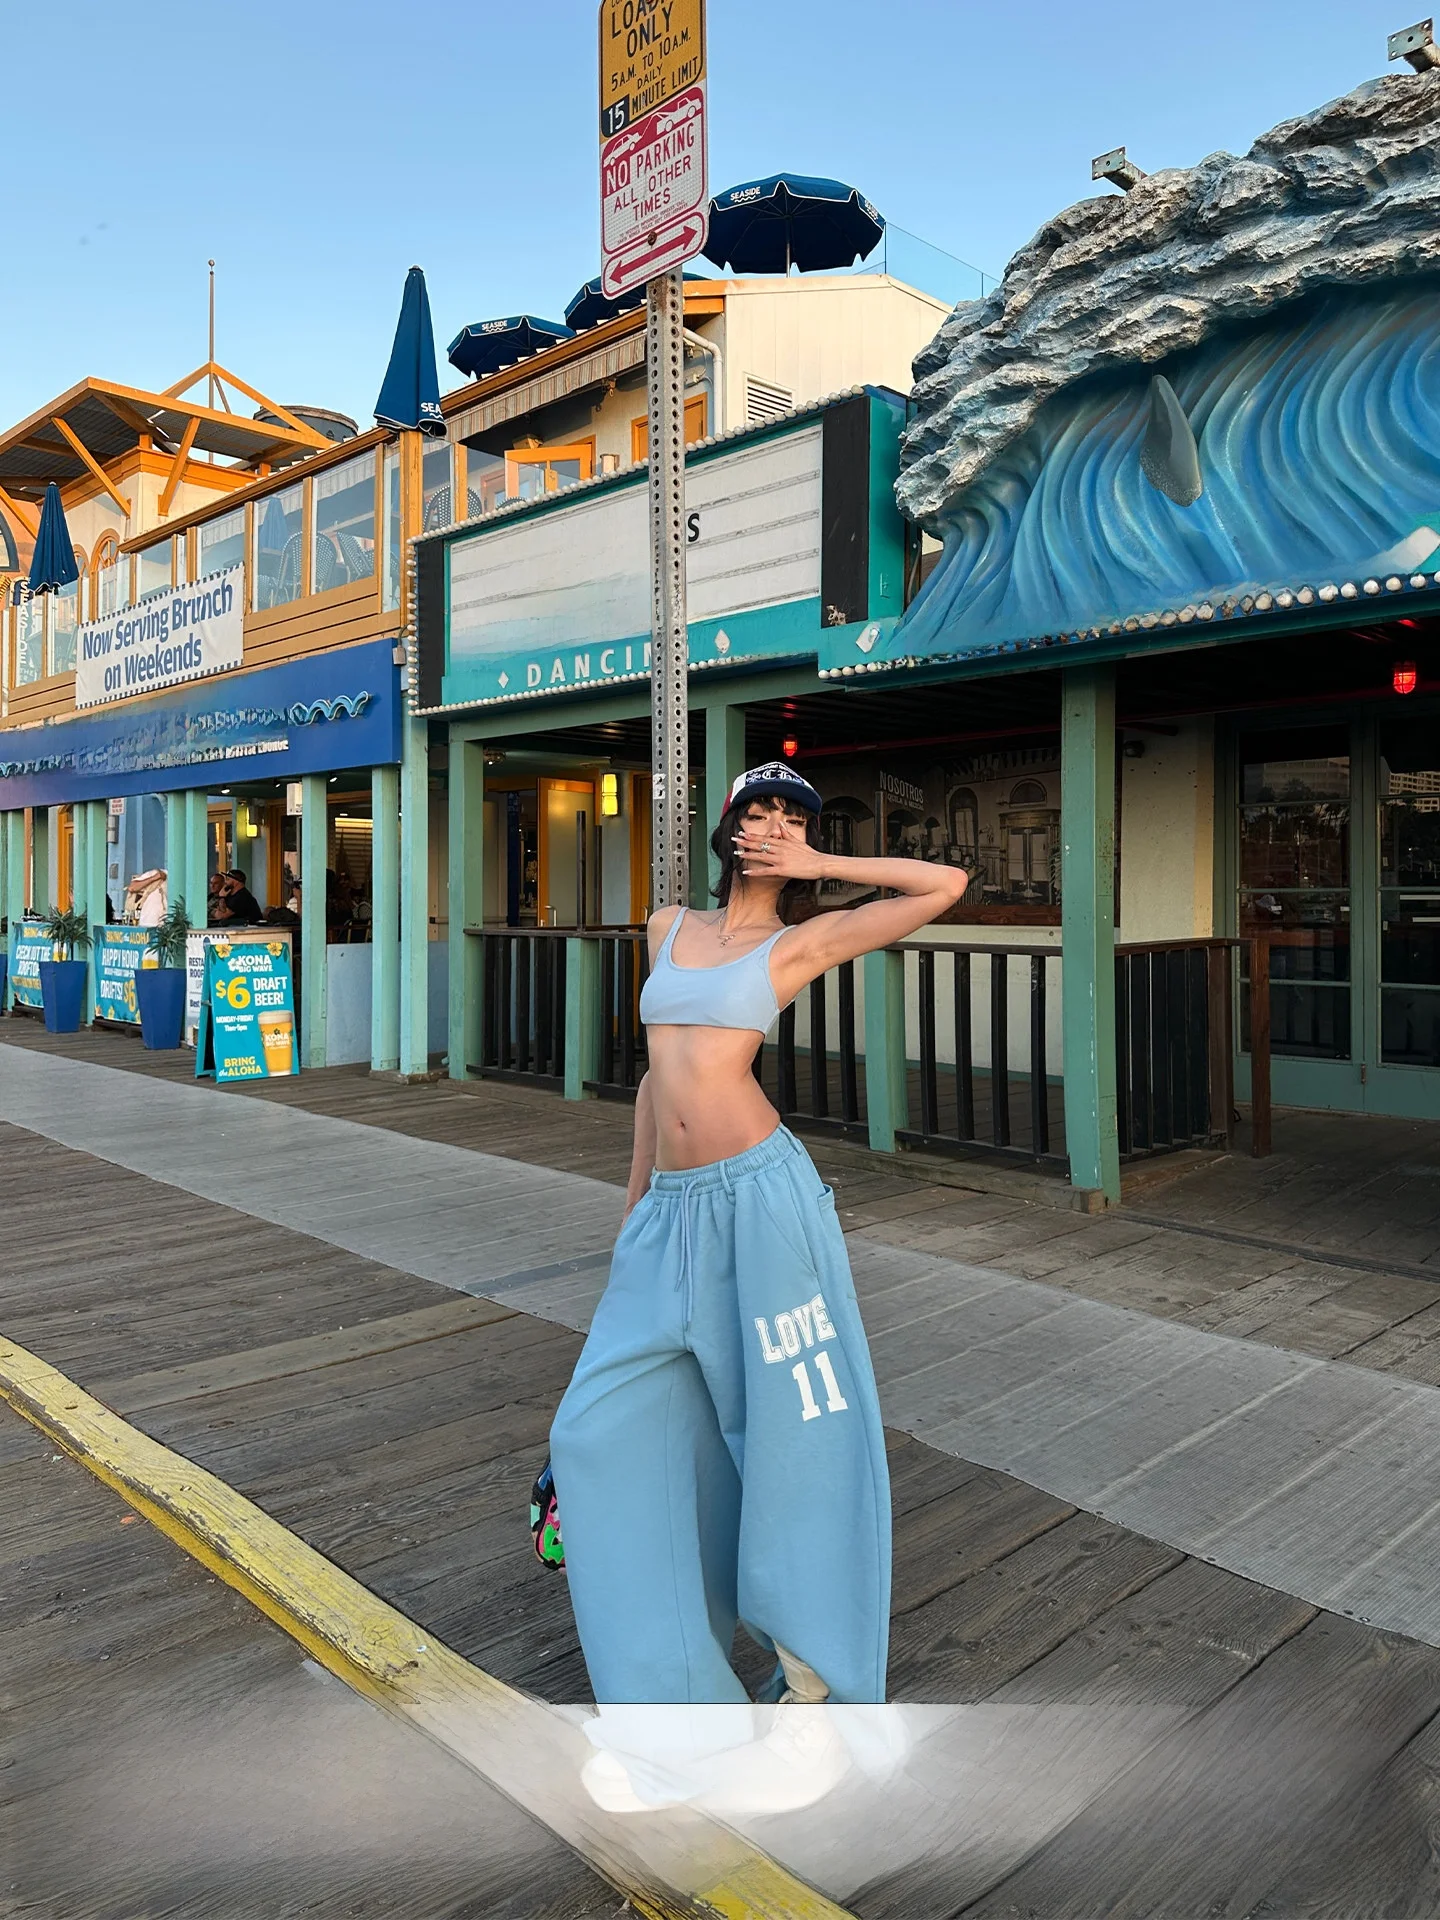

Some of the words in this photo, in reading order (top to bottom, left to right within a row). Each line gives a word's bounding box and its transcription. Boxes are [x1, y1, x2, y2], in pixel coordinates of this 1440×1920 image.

[627, 1, 673, 57] ONLY
[637, 63, 663, 90] DAILY
[643, 52, 654, 71] TO
[608, 100, 625, 134] 15
[631, 77, 666, 115] MINUTE
[671, 56, 698, 90] LIMIT
[606, 160, 628, 196] NO
[636, 122, 695, 178] PARKING
[614, 187, 638, 214] ALL
[648, 154, 691, 192] OTHER
[730, 186, 761, 201] SEASIDE
[632, 187, 671, 221] TIMES
[481, 319, 508, 331] SEASIDE
[687, 512, 700, 543] S
[83, 628, 113, 661] Now
[115, 605, 169, 650] Serving
[172, 578, 233, 631] Brunch
[104, 662, 121, 692] on
[124, 632, 202, 686] Weekends
[527, 635, 689, 688] DANCI
[880, 770, 924, 804] NOSOTROS
[101, 947, 121, 967] HAPPY
[121, 948, 139, 970] HOUR
[237, 954, 272, 966] KONA
[215, 976, 251, 1009] $6
[252, 976, 287, 991] DRAFT
[254, 991, 284, 1007] BEER!
[224, 1056, 256, 1068] BRING
[227, 1065, 263, 1077] ALOHA
[754, 1293, 837, 1365] LOVE
[792, 1350, 849, 1422] 11
